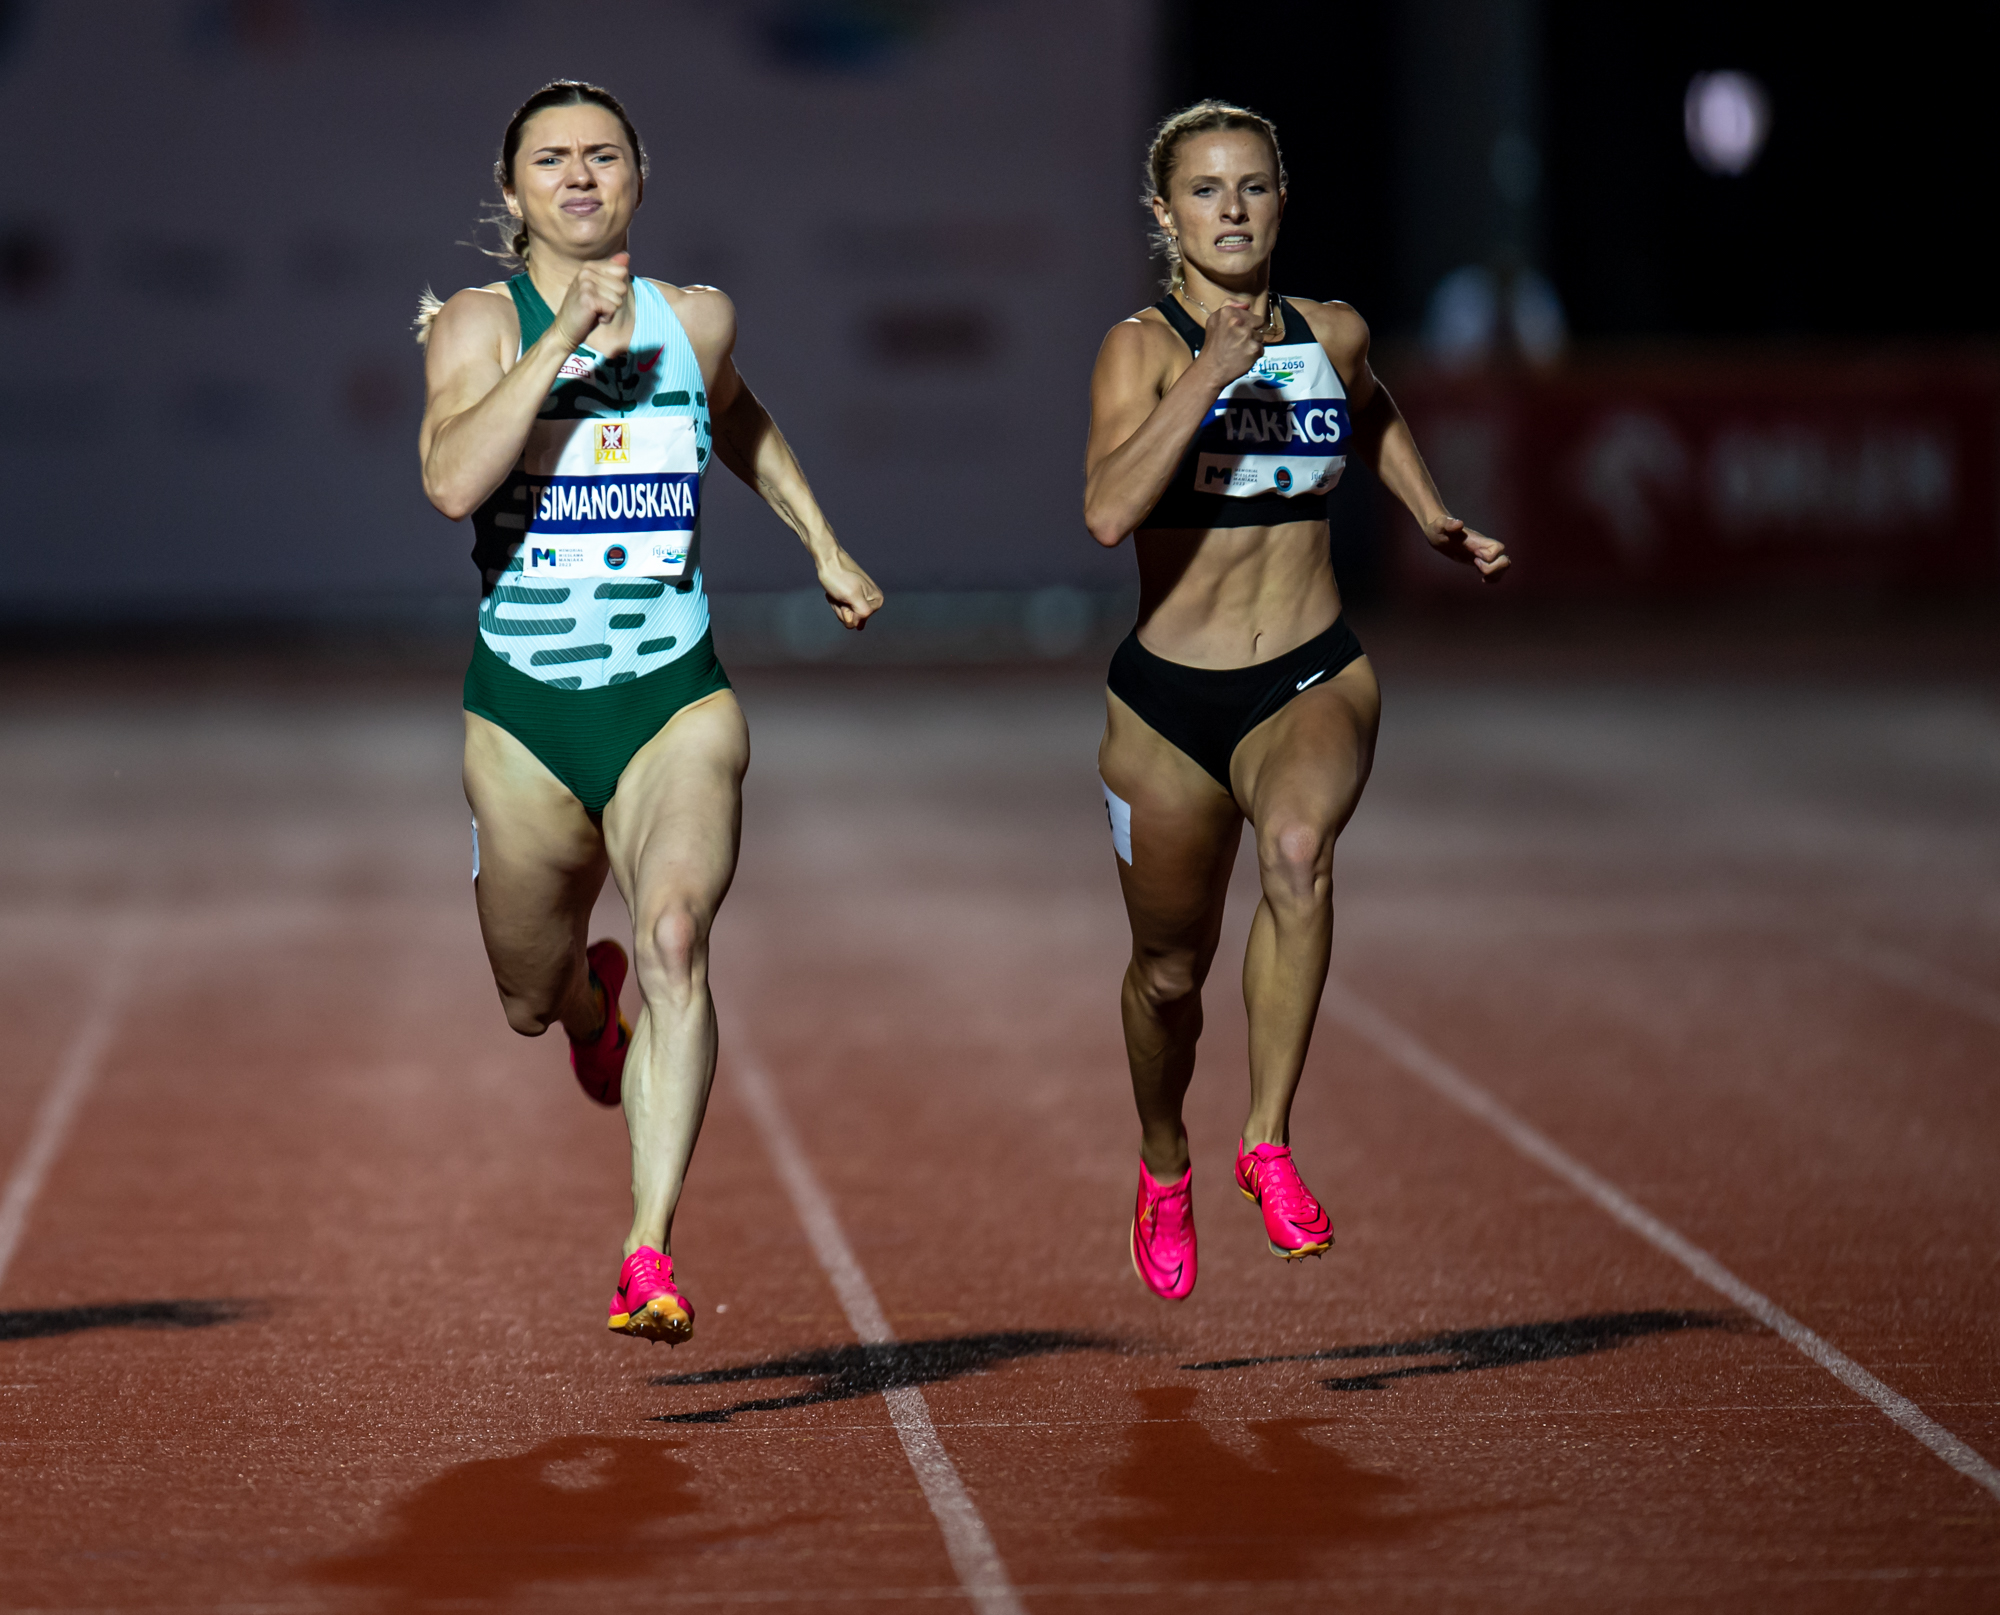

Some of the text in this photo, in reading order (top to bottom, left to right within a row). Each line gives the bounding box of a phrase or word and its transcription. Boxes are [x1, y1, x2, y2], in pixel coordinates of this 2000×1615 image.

[1282, 360, 1305, 370] 2050
[1214, 402, 1341, 443] TAKÁCS
[596, 450, 628, 462] PZLA
[530, 482, 695, 521] TSIMANOUSKAYA
